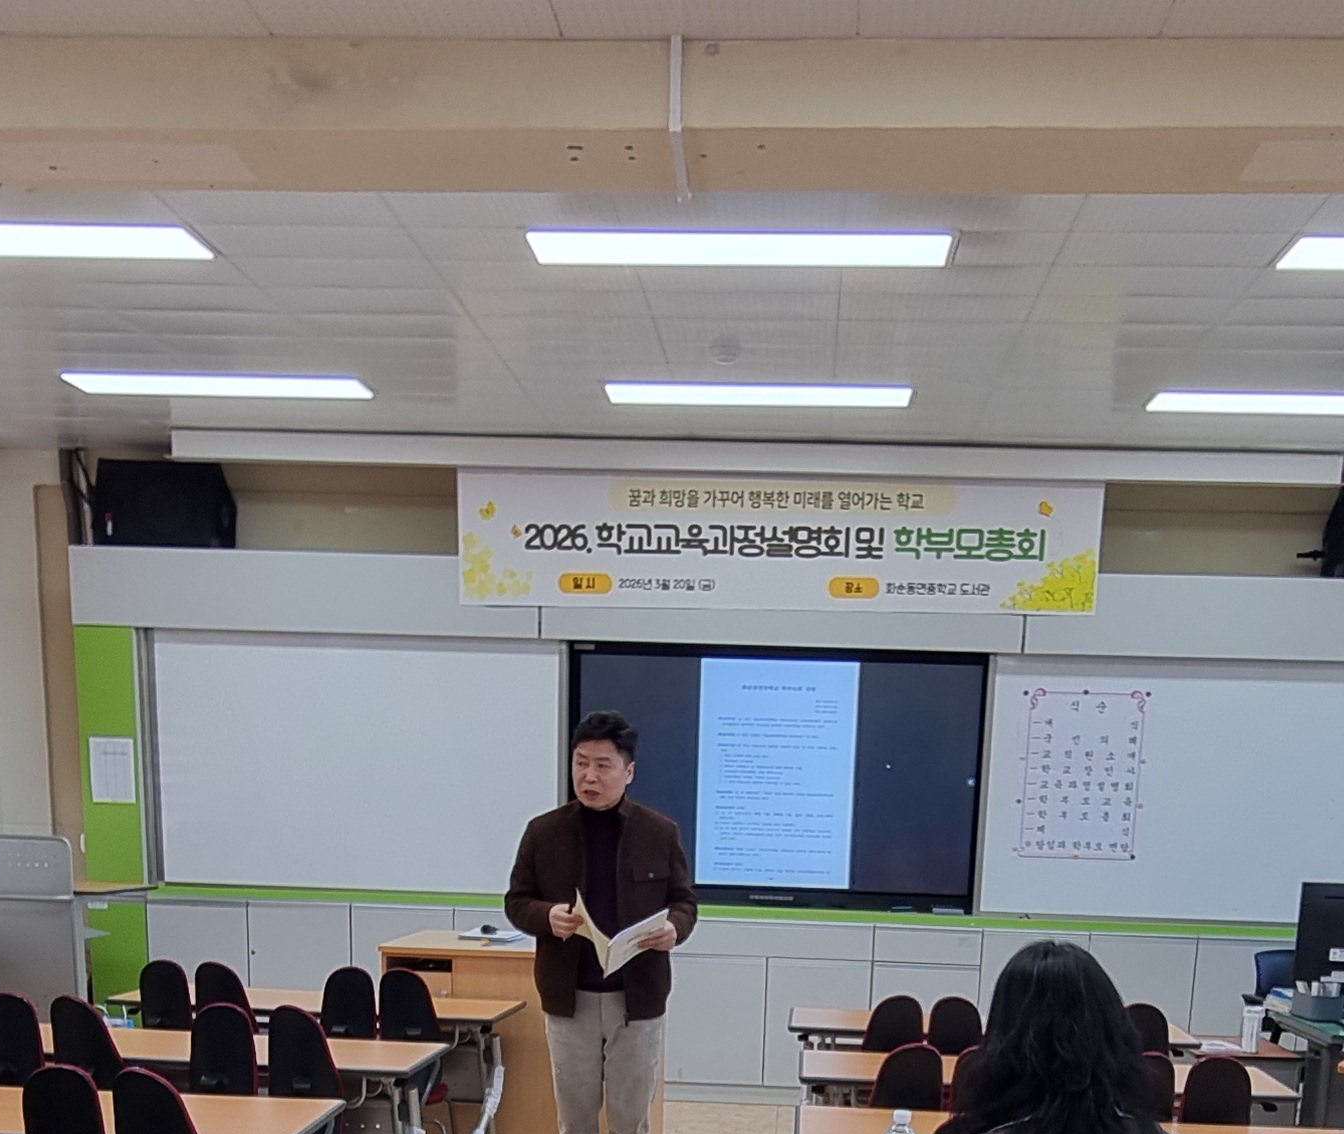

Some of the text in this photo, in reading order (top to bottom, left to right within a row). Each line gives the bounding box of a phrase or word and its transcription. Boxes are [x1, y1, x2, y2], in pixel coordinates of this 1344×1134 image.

[628, 488, 925, 511] 꿈과 희망을 가꾸어 행복한 미래를 열어가는 학교
[524, 522, 1047, 562] 2026. 학교교육과정설명회 및 학부모총회
